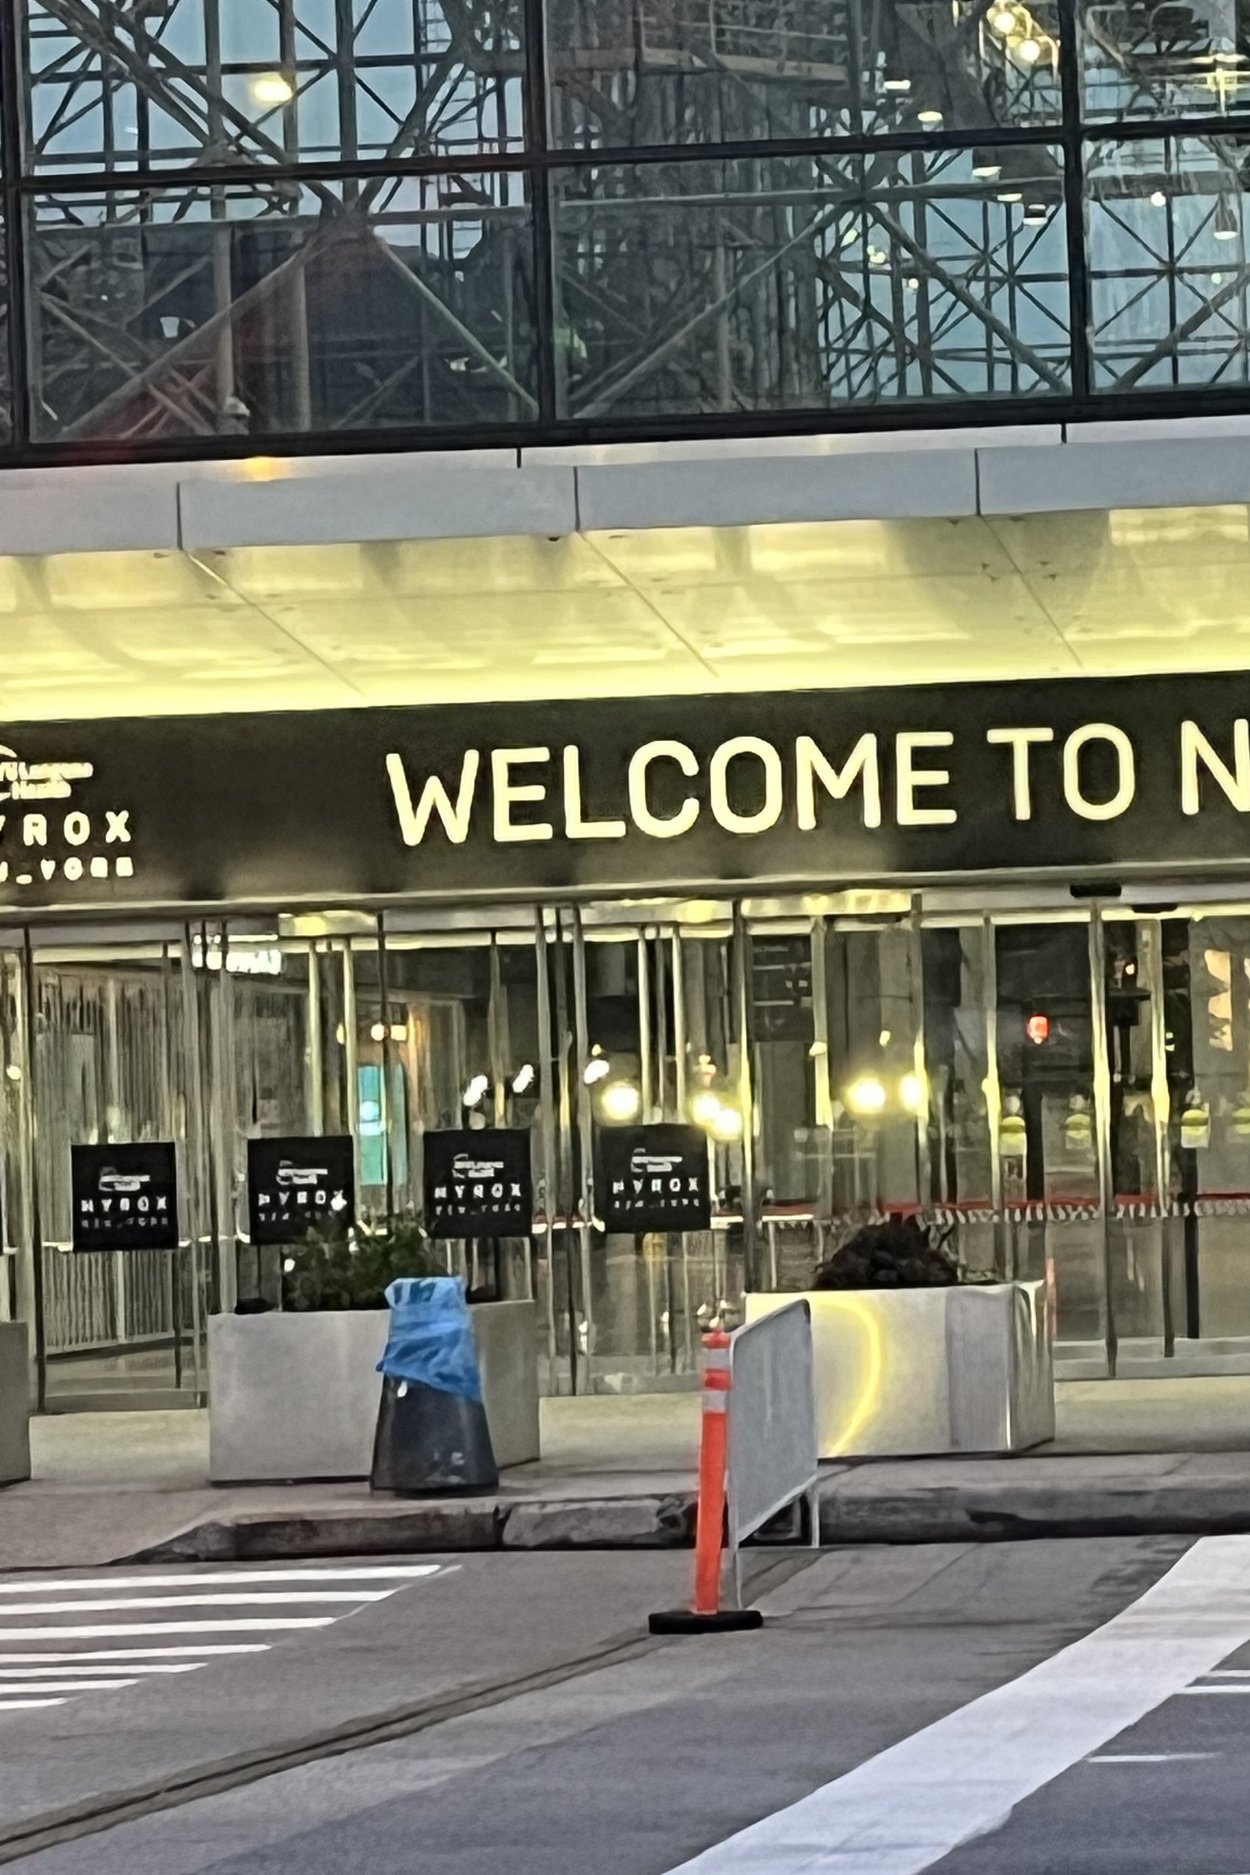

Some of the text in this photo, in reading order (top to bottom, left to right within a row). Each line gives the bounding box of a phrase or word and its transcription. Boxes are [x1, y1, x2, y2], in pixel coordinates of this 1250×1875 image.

[386, 731, 958, 846] WELCOME
[987, 723, 1136, 821] TO
[0, 809, 132, 847] ROX
